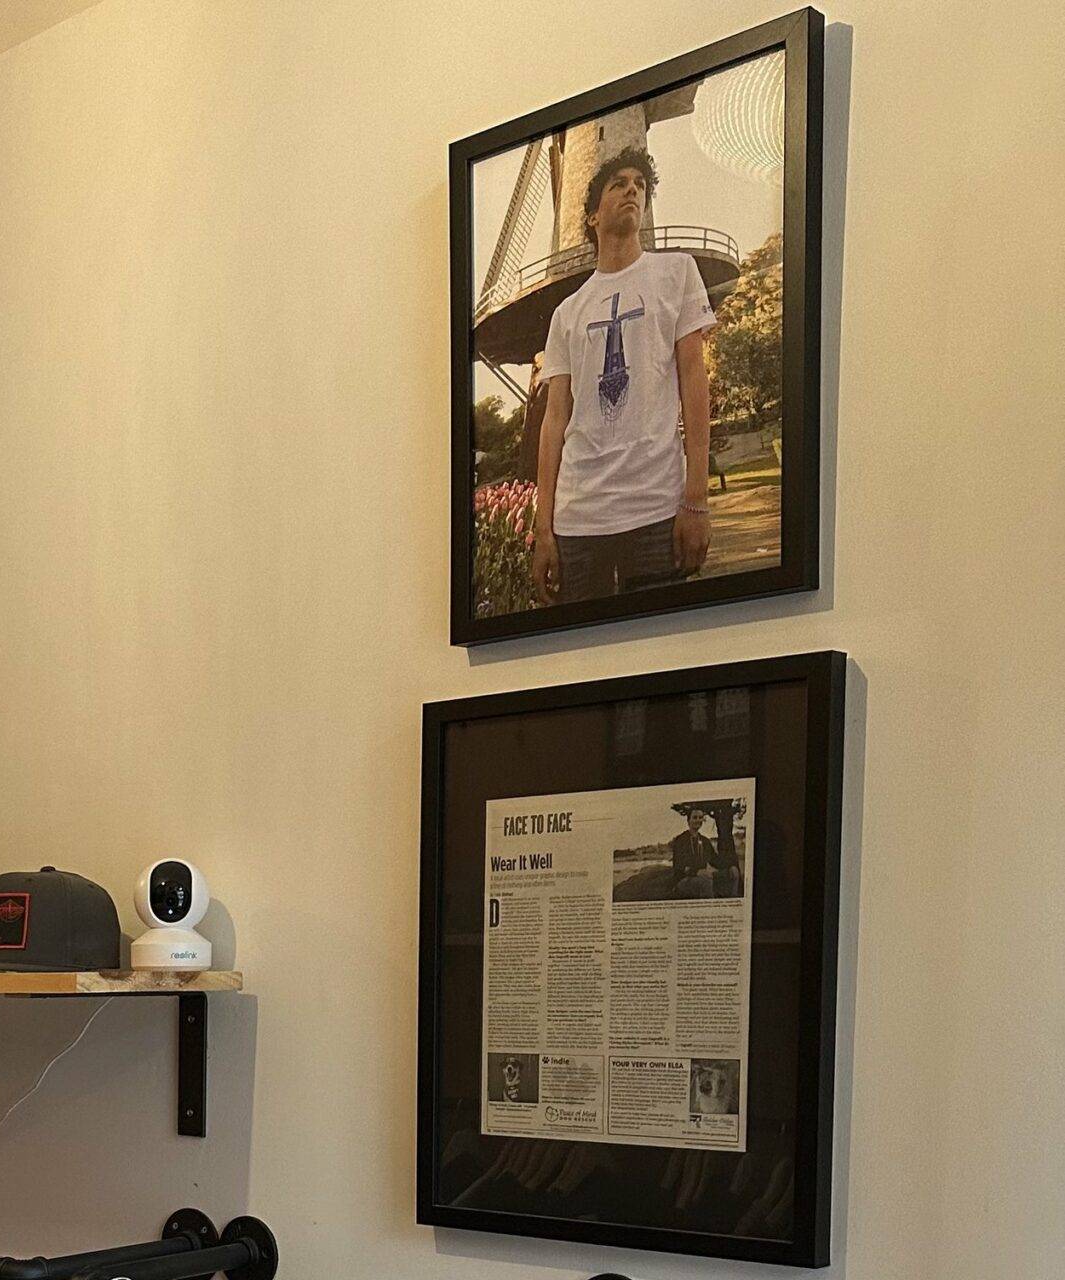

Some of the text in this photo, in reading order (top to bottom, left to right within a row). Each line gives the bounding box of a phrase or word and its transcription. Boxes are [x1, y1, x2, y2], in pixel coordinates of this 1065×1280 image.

[504, 812, 572, 836] FACE TO FACE
[491, 853, 552, 872] Wear It Well
